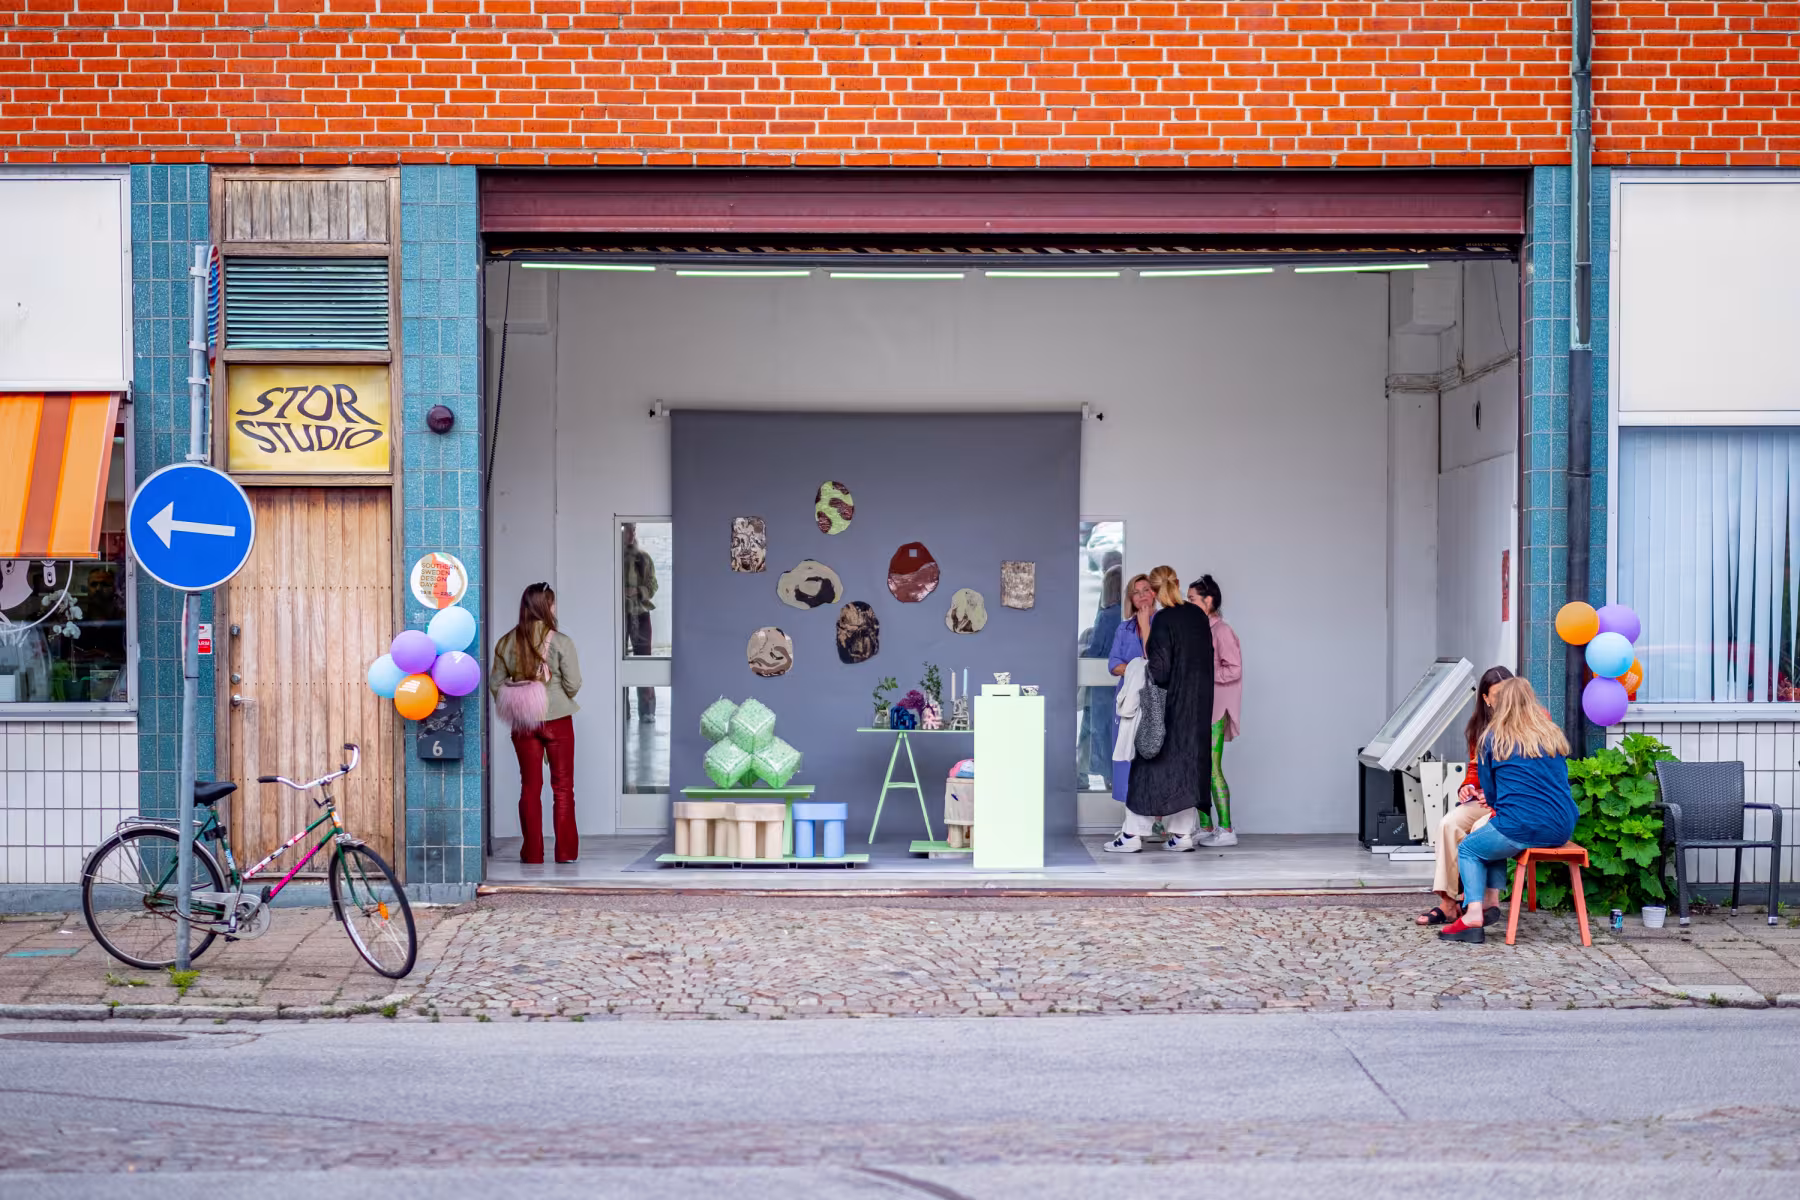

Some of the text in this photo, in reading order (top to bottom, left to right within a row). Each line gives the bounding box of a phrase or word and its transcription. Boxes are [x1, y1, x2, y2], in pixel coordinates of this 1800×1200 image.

[236, 384, 382, 425] STOR
[236, 420, 383, 453] STUDIO
[432, 740, 443, 756] 6
